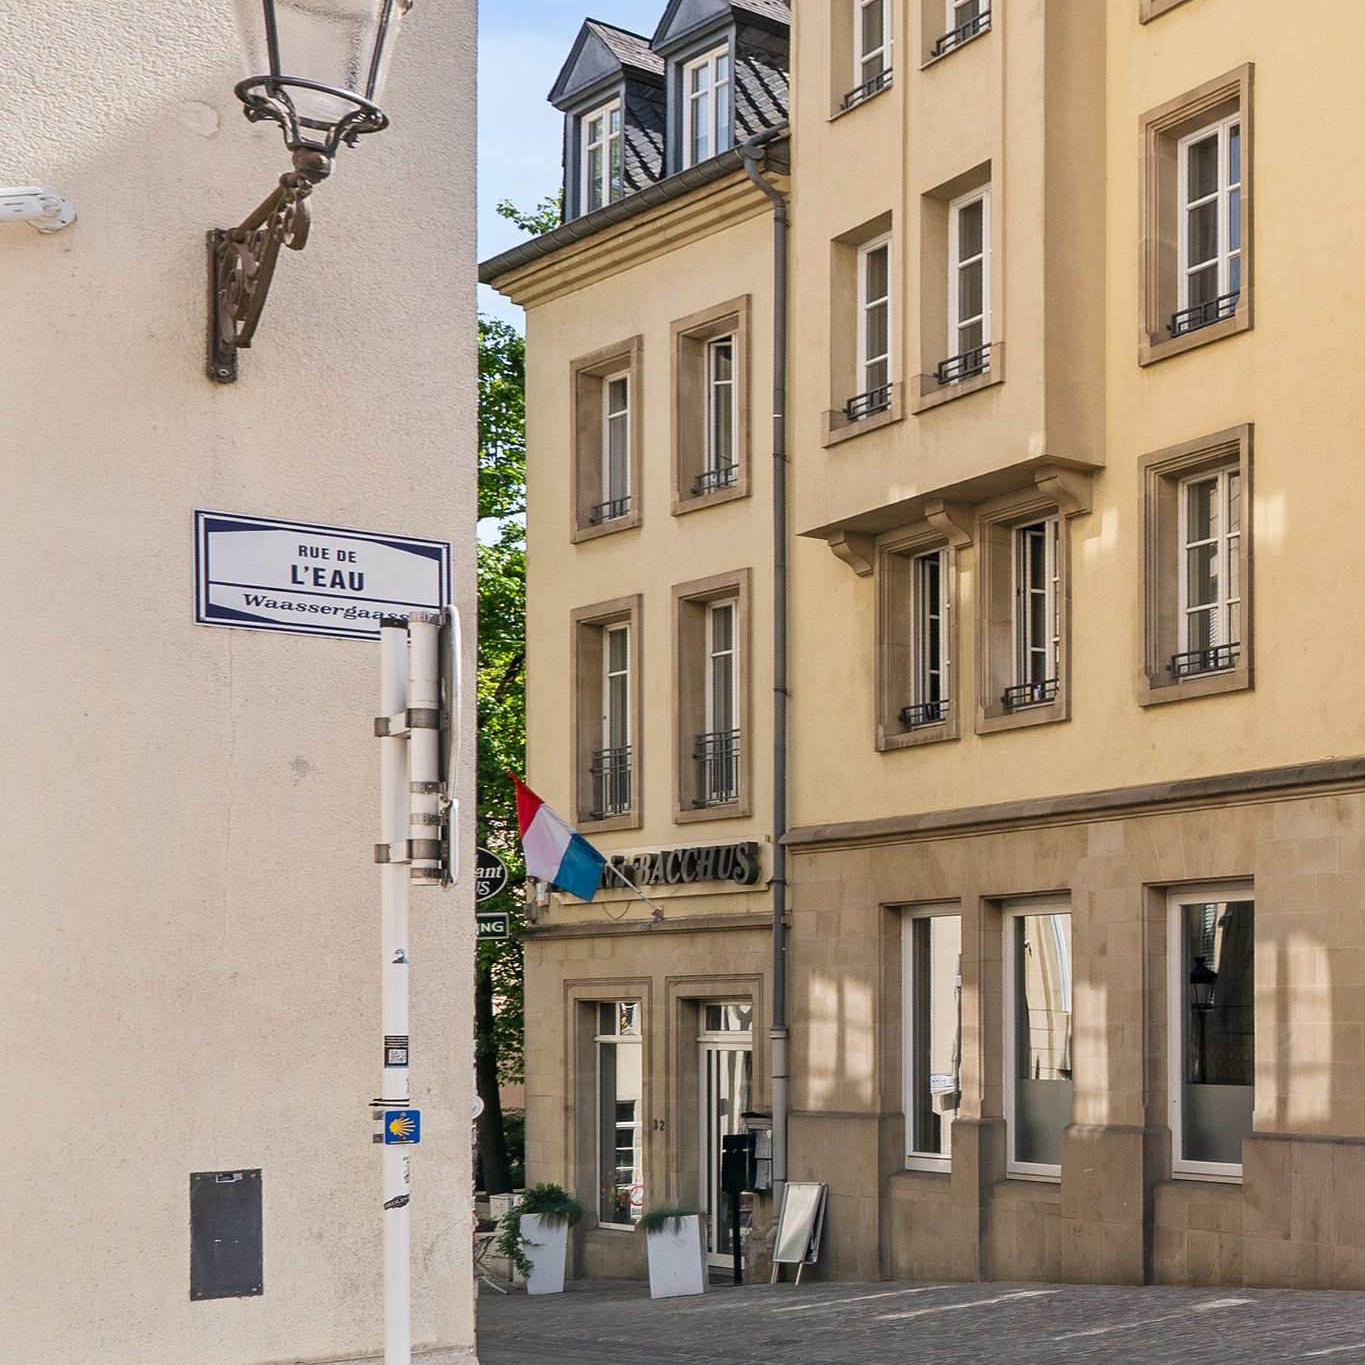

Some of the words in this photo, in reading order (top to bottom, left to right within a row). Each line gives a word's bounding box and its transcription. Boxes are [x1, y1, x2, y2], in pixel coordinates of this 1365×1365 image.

[298, 544, 329, 560] RUE
[336, 549, 357, 563] DE
[290, 564, 365, 592] L'EAU
[632, 842, 758, 885] BACCHUS
[653, 1119, 665, 1131] 32
